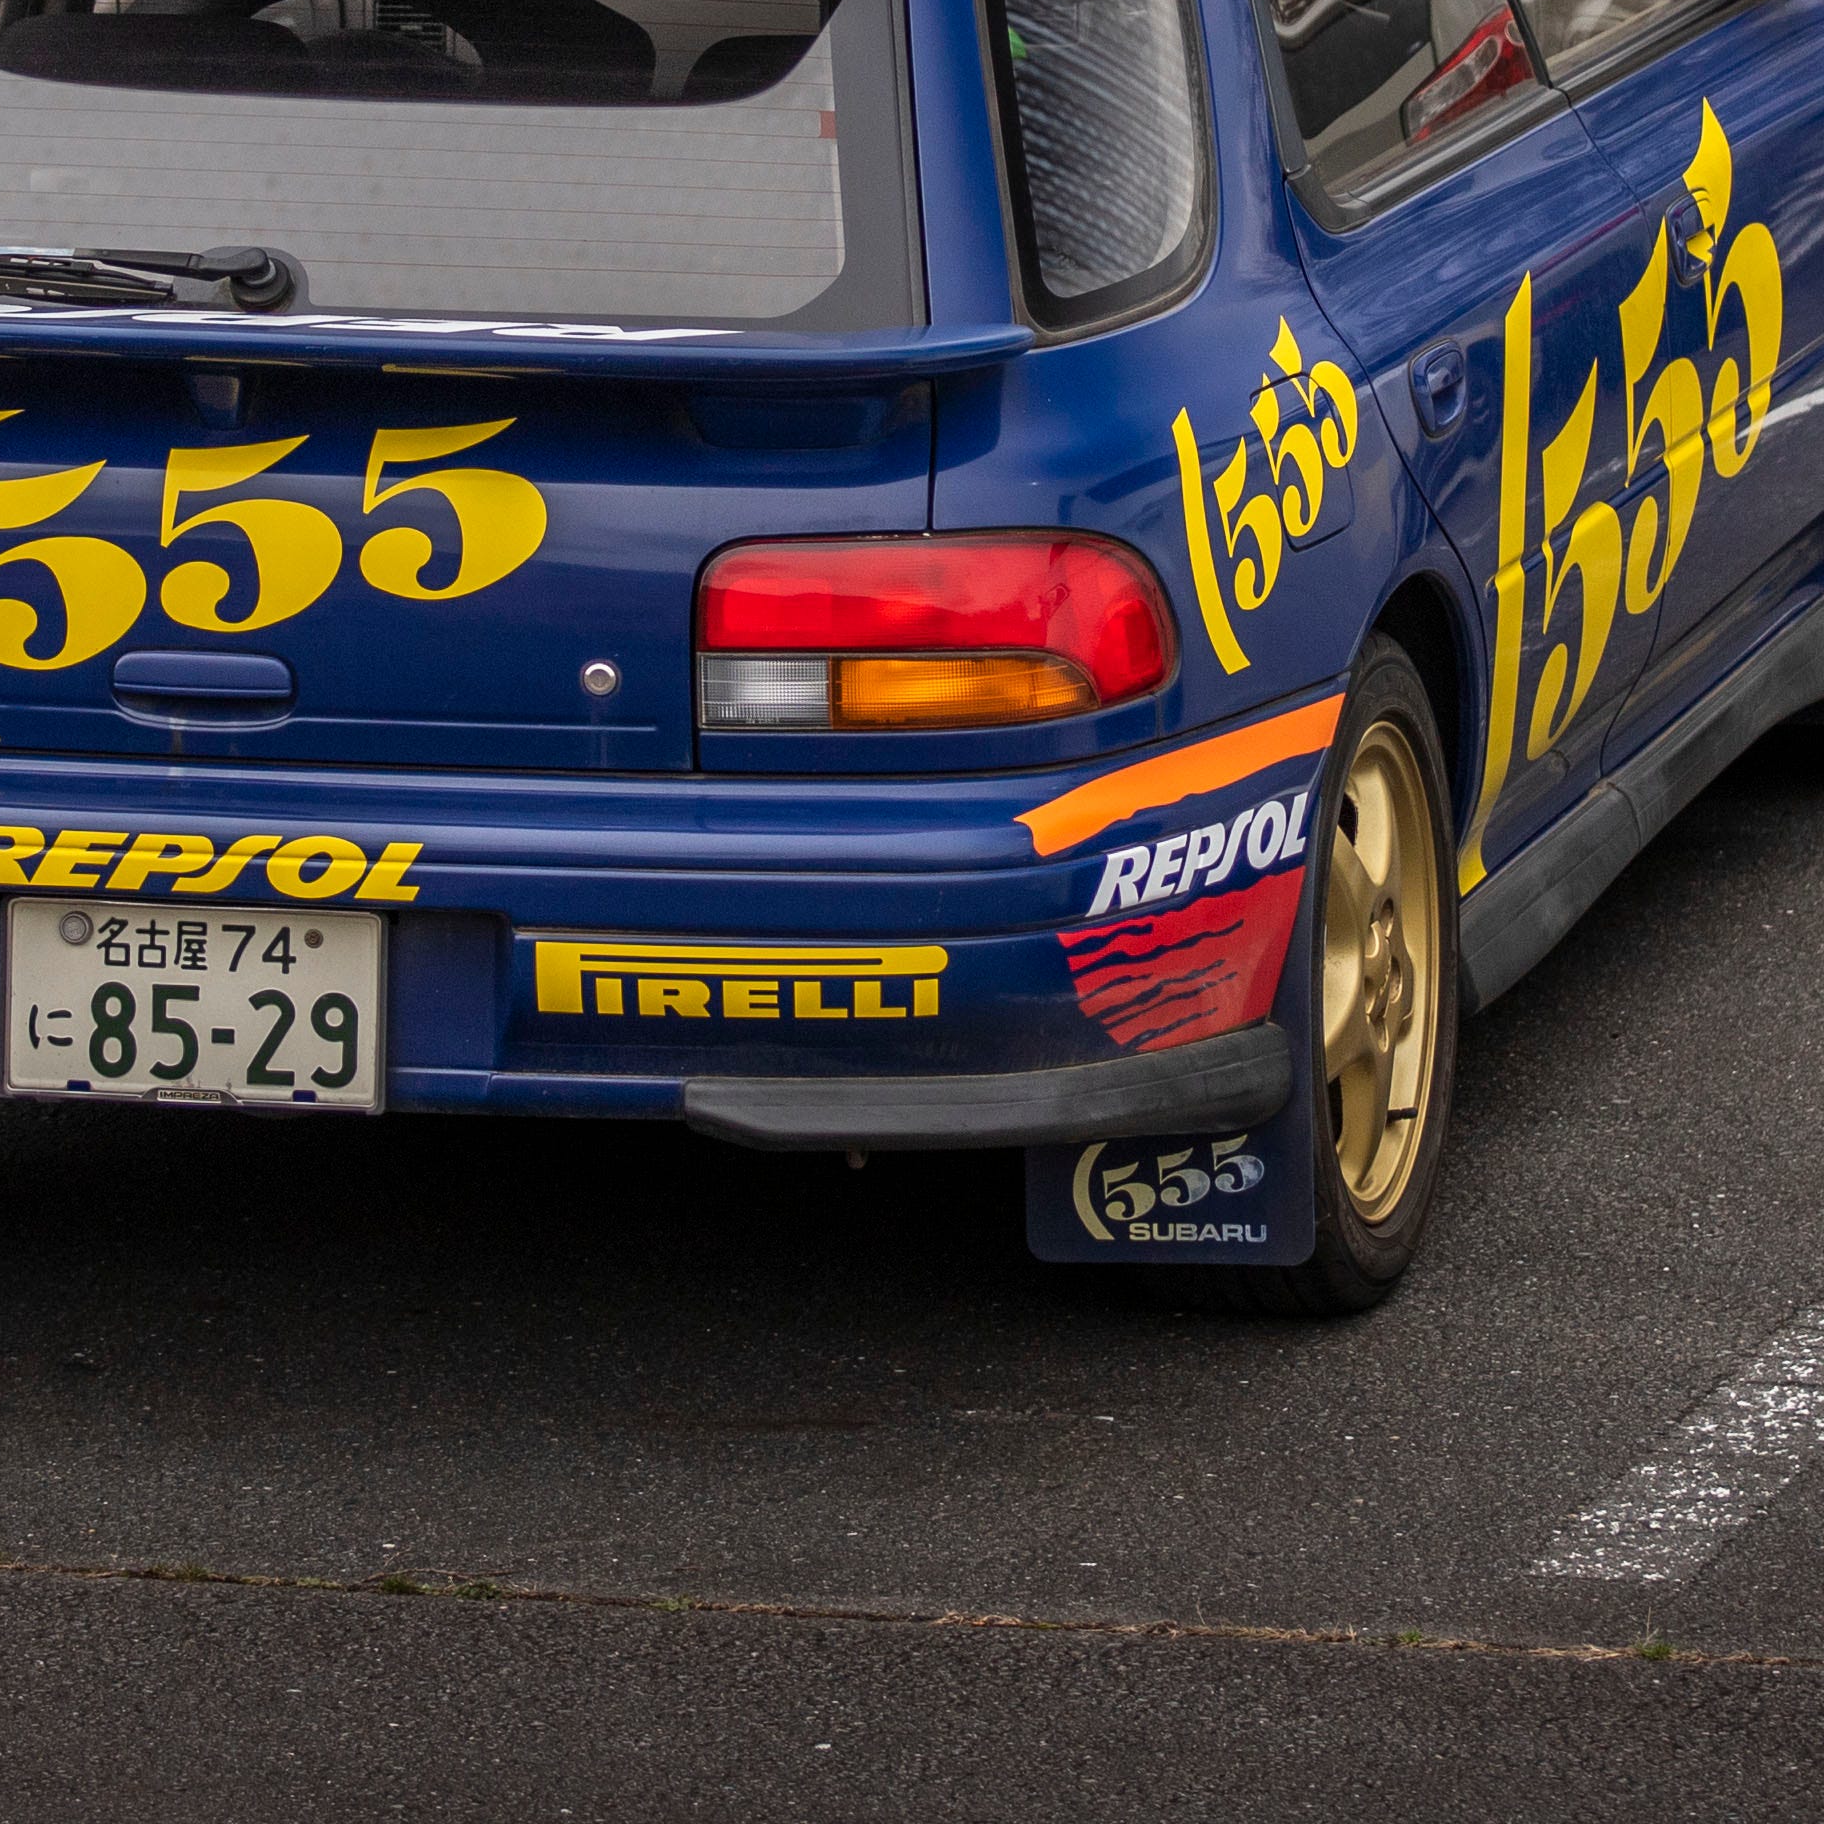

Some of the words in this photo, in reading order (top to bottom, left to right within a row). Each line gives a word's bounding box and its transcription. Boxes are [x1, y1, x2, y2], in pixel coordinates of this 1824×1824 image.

[1085, 790, 1310, 918] REPSOL
[535, 941, 950, 1019] PIRELLI
[28, 1004, 74, 1050] に
[88, 981, 360, 1090] 85-29
[159, 1090, 220, 1100] IMPREZA
[1128, 1222, 1267, 1244] SUBARU
